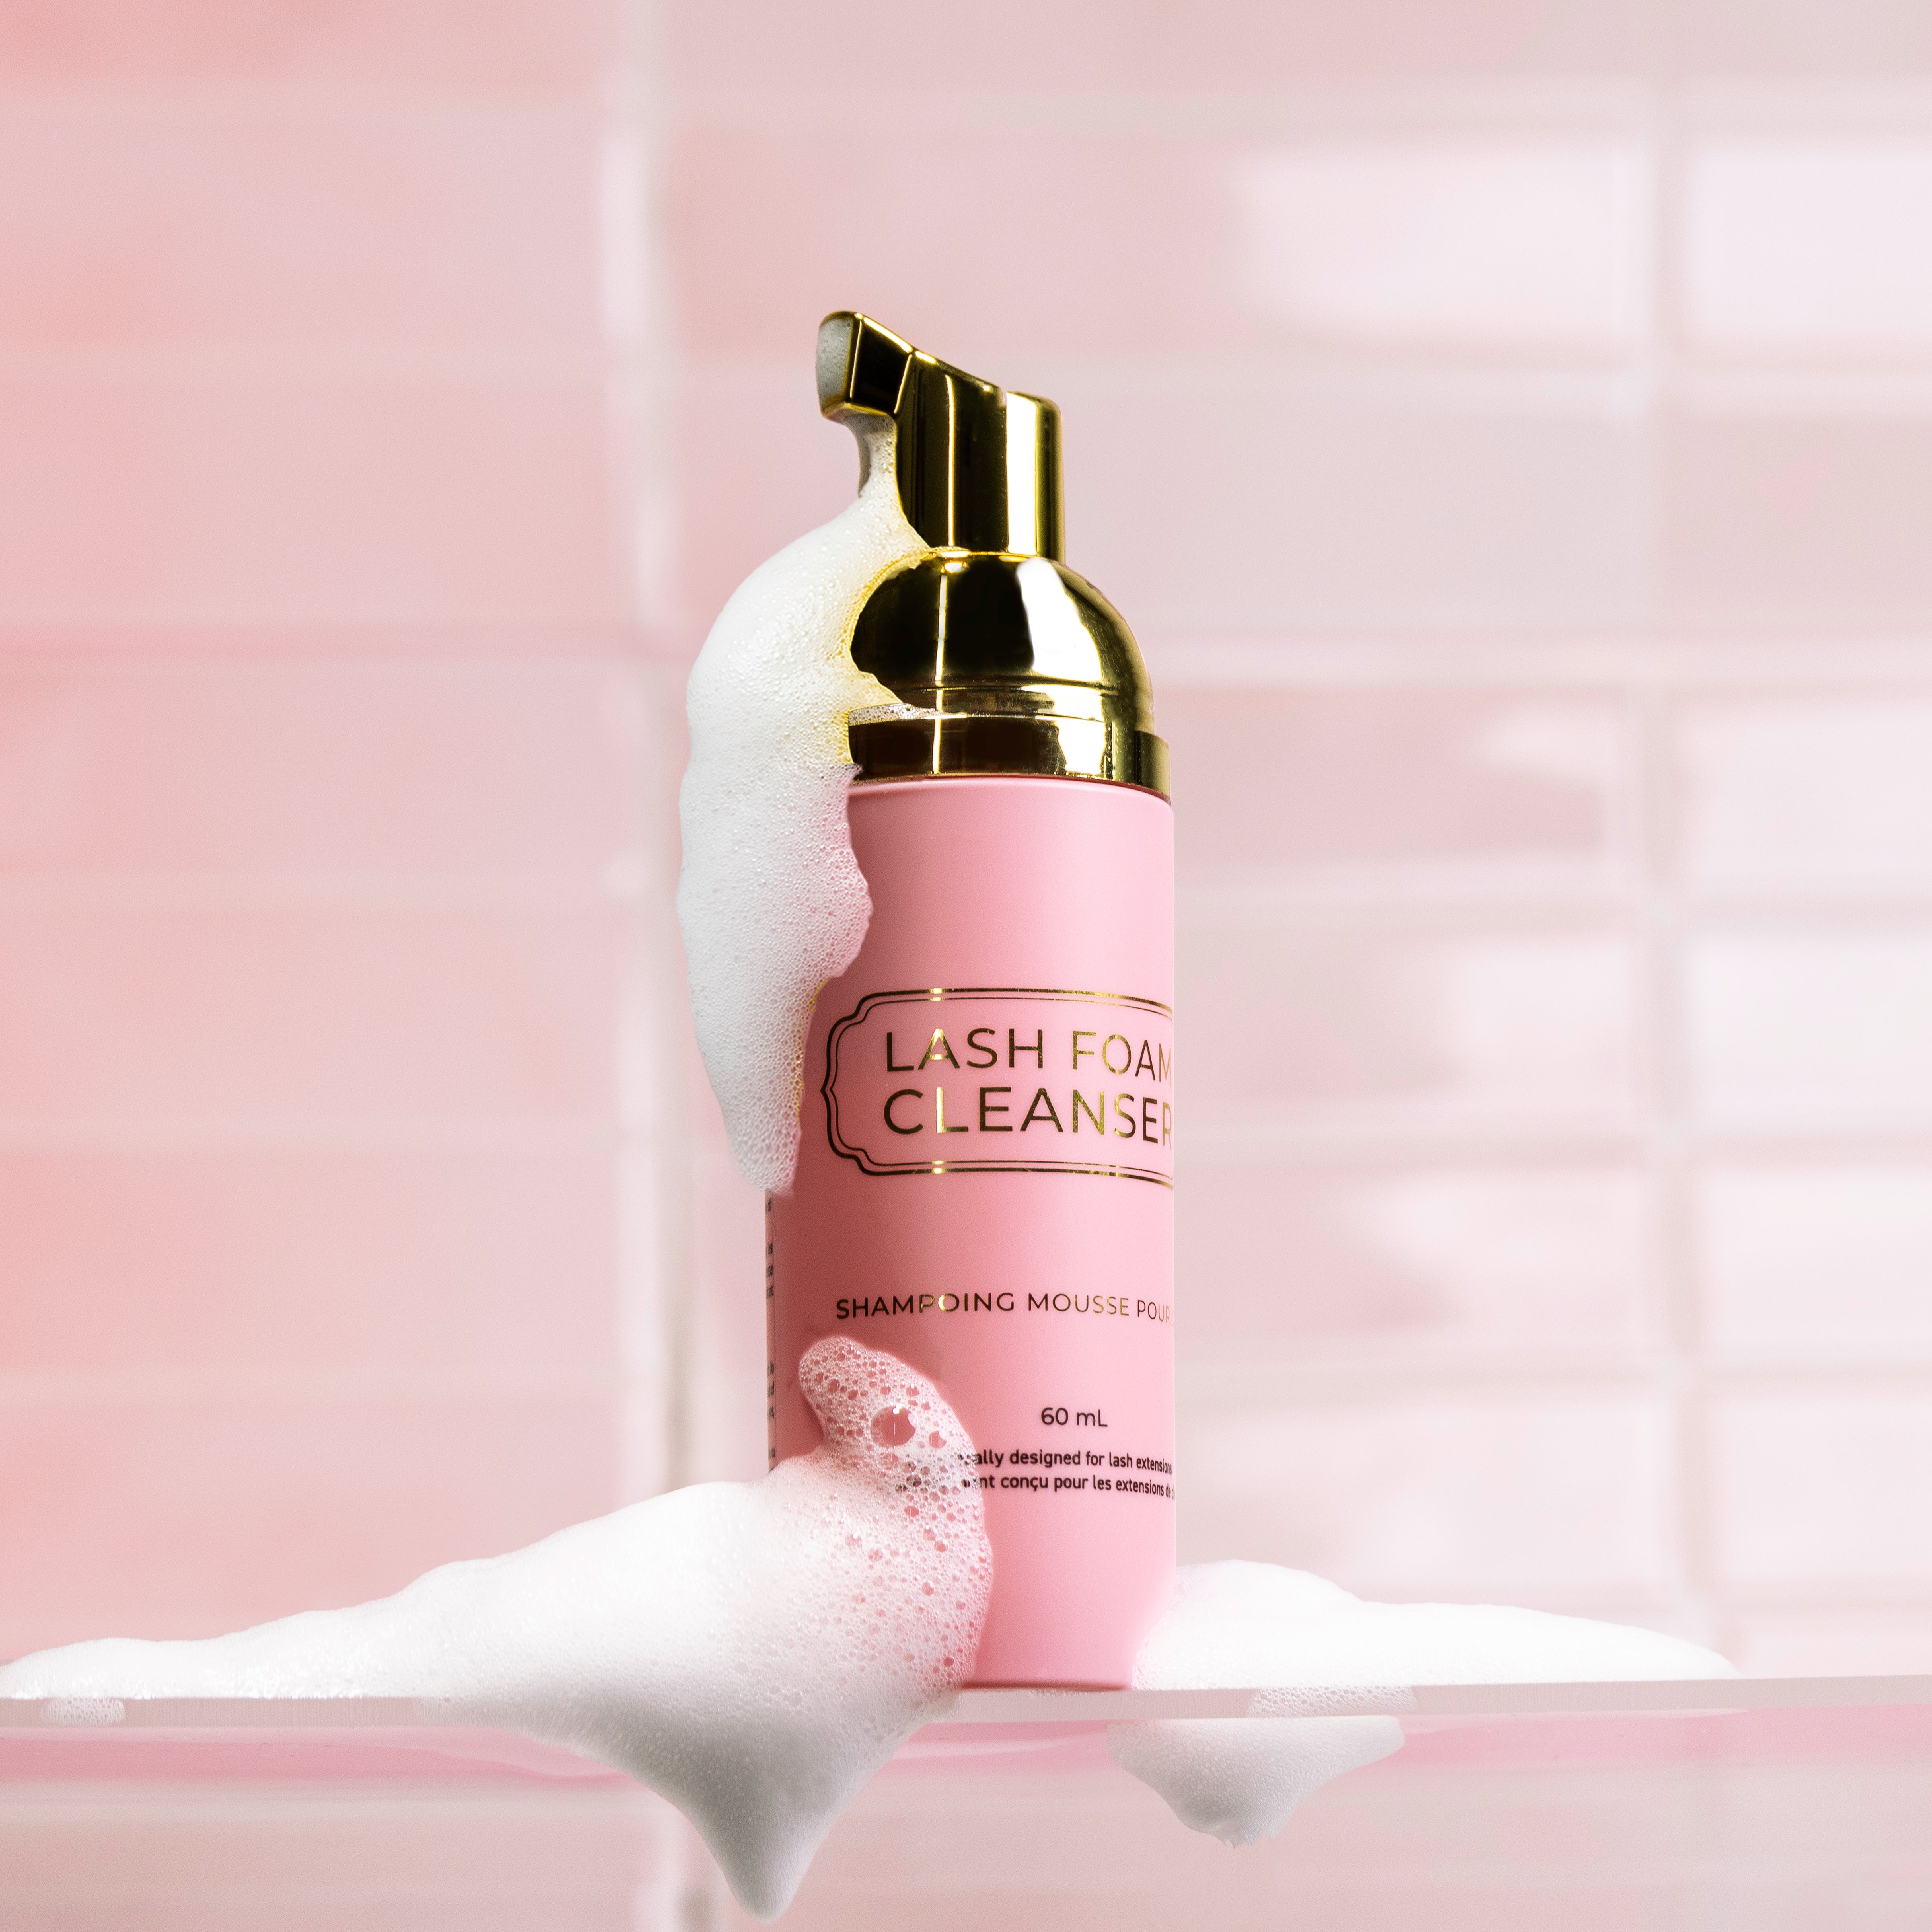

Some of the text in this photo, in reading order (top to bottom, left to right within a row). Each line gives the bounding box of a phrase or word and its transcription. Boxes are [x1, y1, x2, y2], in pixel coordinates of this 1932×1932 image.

[886, 1028, 1171, 1088] LASH FOAM
[883, 1087, 1171, 1150] CLEANSER
[836, 1292, 1015, 1319] SHAMPOING
[1028, 1293, 1130, 1316] MOUSSE
[1137, 1299, 1170, 1324] POUR
[1040, 1407, 1108, 1427] 60 mL
[1009, 1449, 1081, 1468] designed
[1085, 1451, 1105, 1466] for
[1109, 1451, 1133, 1468] lash
[1136, 1457, 1172, 1475] extensions
[1000, 1476, 1049, 1492] conçu
[1054, 1477, 1089, 1492] pour
[1093, 1474, 1112, 1491] les
[1115, 1478, 1164, 1496] extensions
[1165, 1483, 1171, 1498] de
